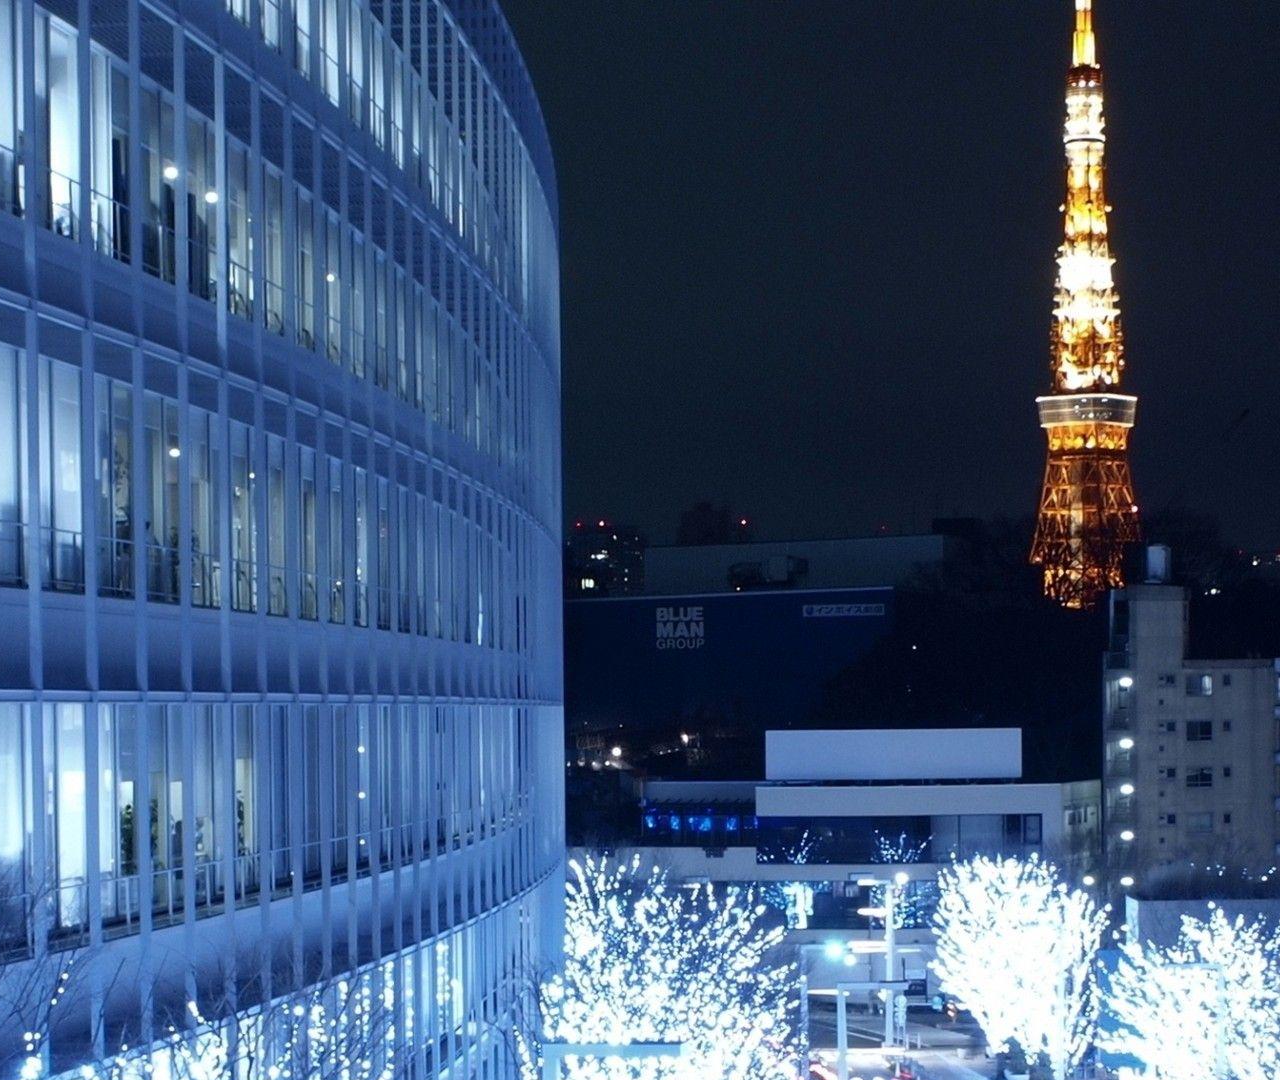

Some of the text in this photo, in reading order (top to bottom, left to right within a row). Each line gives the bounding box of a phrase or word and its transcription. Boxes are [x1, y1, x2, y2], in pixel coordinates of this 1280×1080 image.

[656, 607, 704, 621] BLUE
[656, 622, 704, 638] MAN
[656, 638, 705, 649] GROUP
